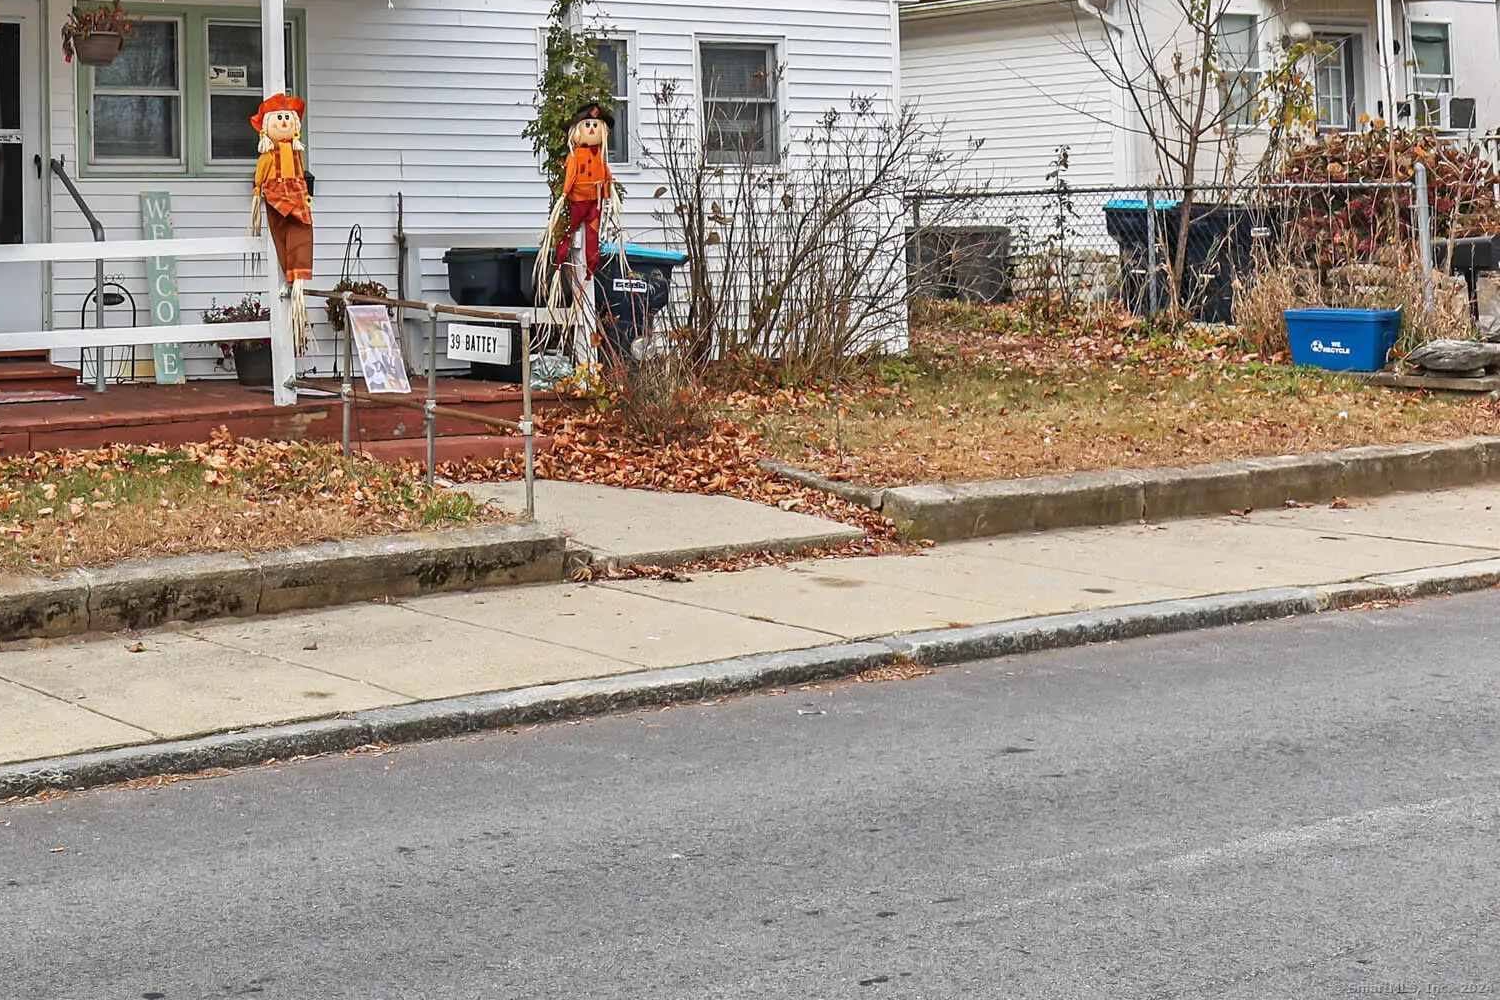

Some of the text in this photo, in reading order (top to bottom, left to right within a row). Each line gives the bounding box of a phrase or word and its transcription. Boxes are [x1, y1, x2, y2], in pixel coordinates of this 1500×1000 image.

[145, 198, 179, 375] WELCOE
[450, 334, 498, 354] 39 BATTEY
